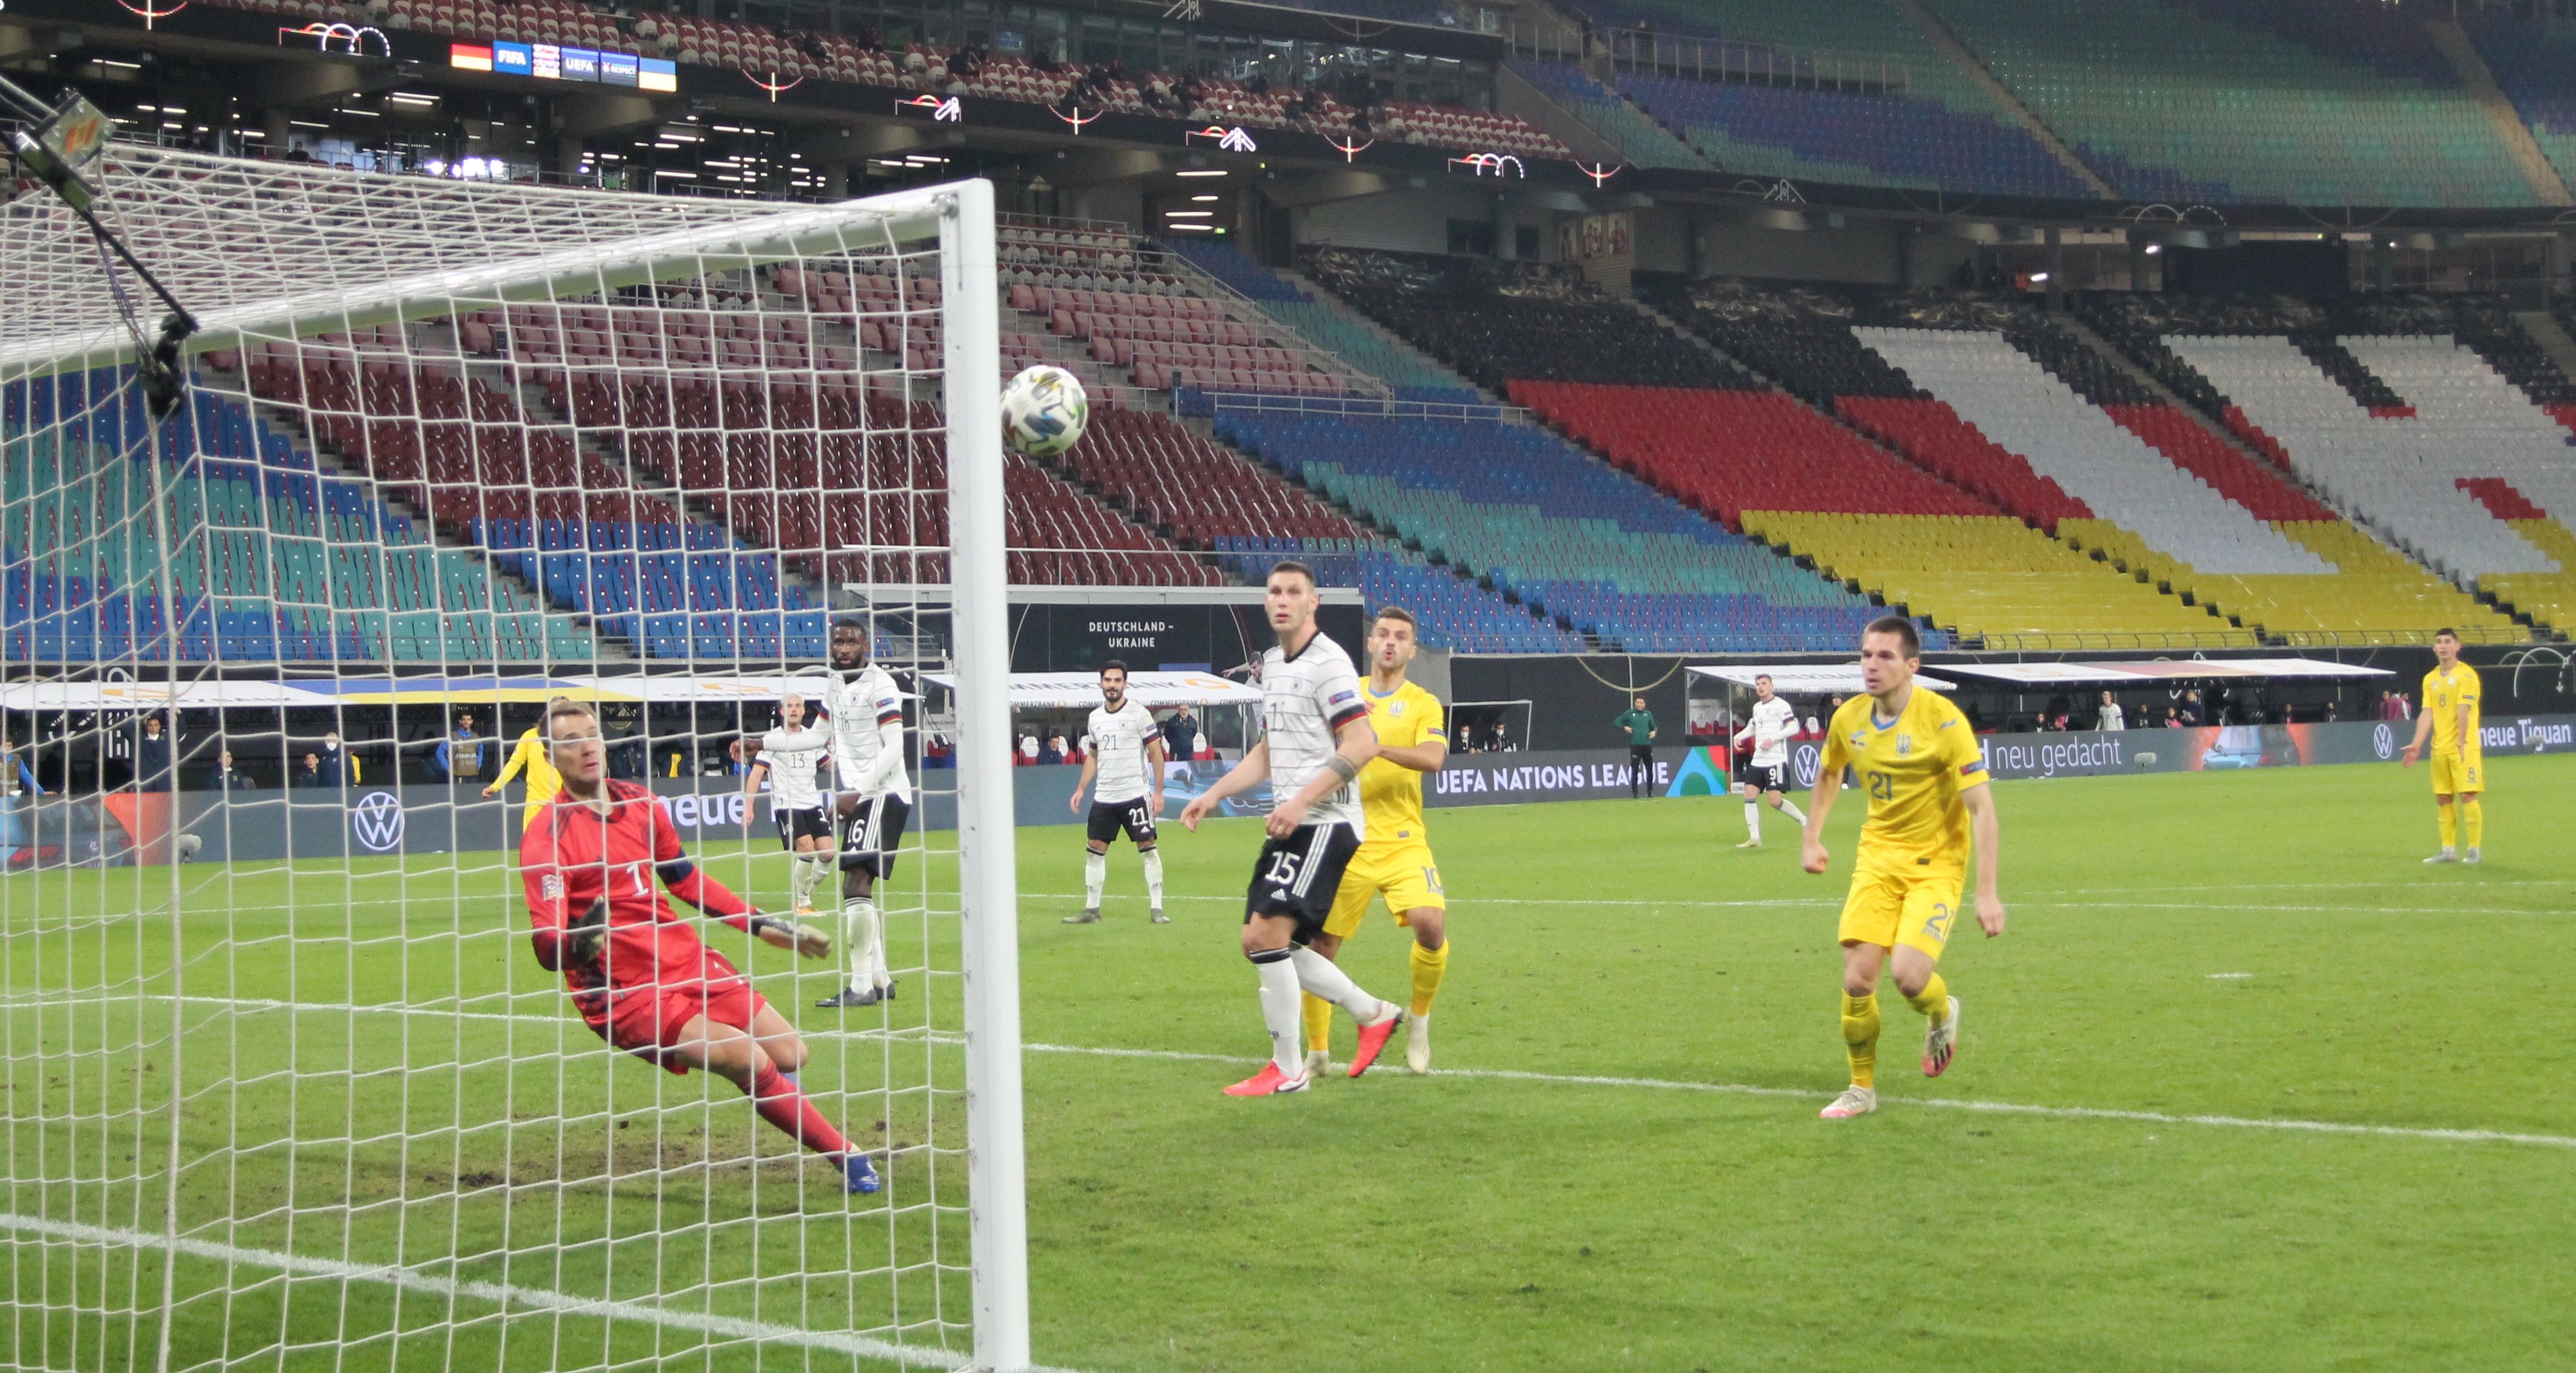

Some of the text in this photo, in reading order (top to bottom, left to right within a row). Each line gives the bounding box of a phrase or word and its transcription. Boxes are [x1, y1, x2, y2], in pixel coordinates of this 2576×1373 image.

[497, 49, 526, 65] FIFA
[566, 57, 594, 72] UEFA
[611, 65, 636, 75] RESPECT
[1088, 621, 1166, 632] DEUTSCHLAND
[1108, 637, 1155, 648] UKRAINE
[2439, 694, 2446, 707] 8
[1102, 734, 1119, 750] 21
[2479, 718, 2572, 752] neue Tiguan
[791, 753, 805, 768] 13
[1996, 745, 2034, 769] neu
[2041, 734, 2122, 776] gedacht
[1436, 769, 1488, 794] UEFA
[1492, 765, 1585, 792] NATIONS
[1769, 768, 1777, 780] 9
[1868, 770, 1892, 801] 21
[1129, 807, 1148, 826] 21
[1265, 851, 1300, 884] 15
[626, 862, 649, 896] 1
